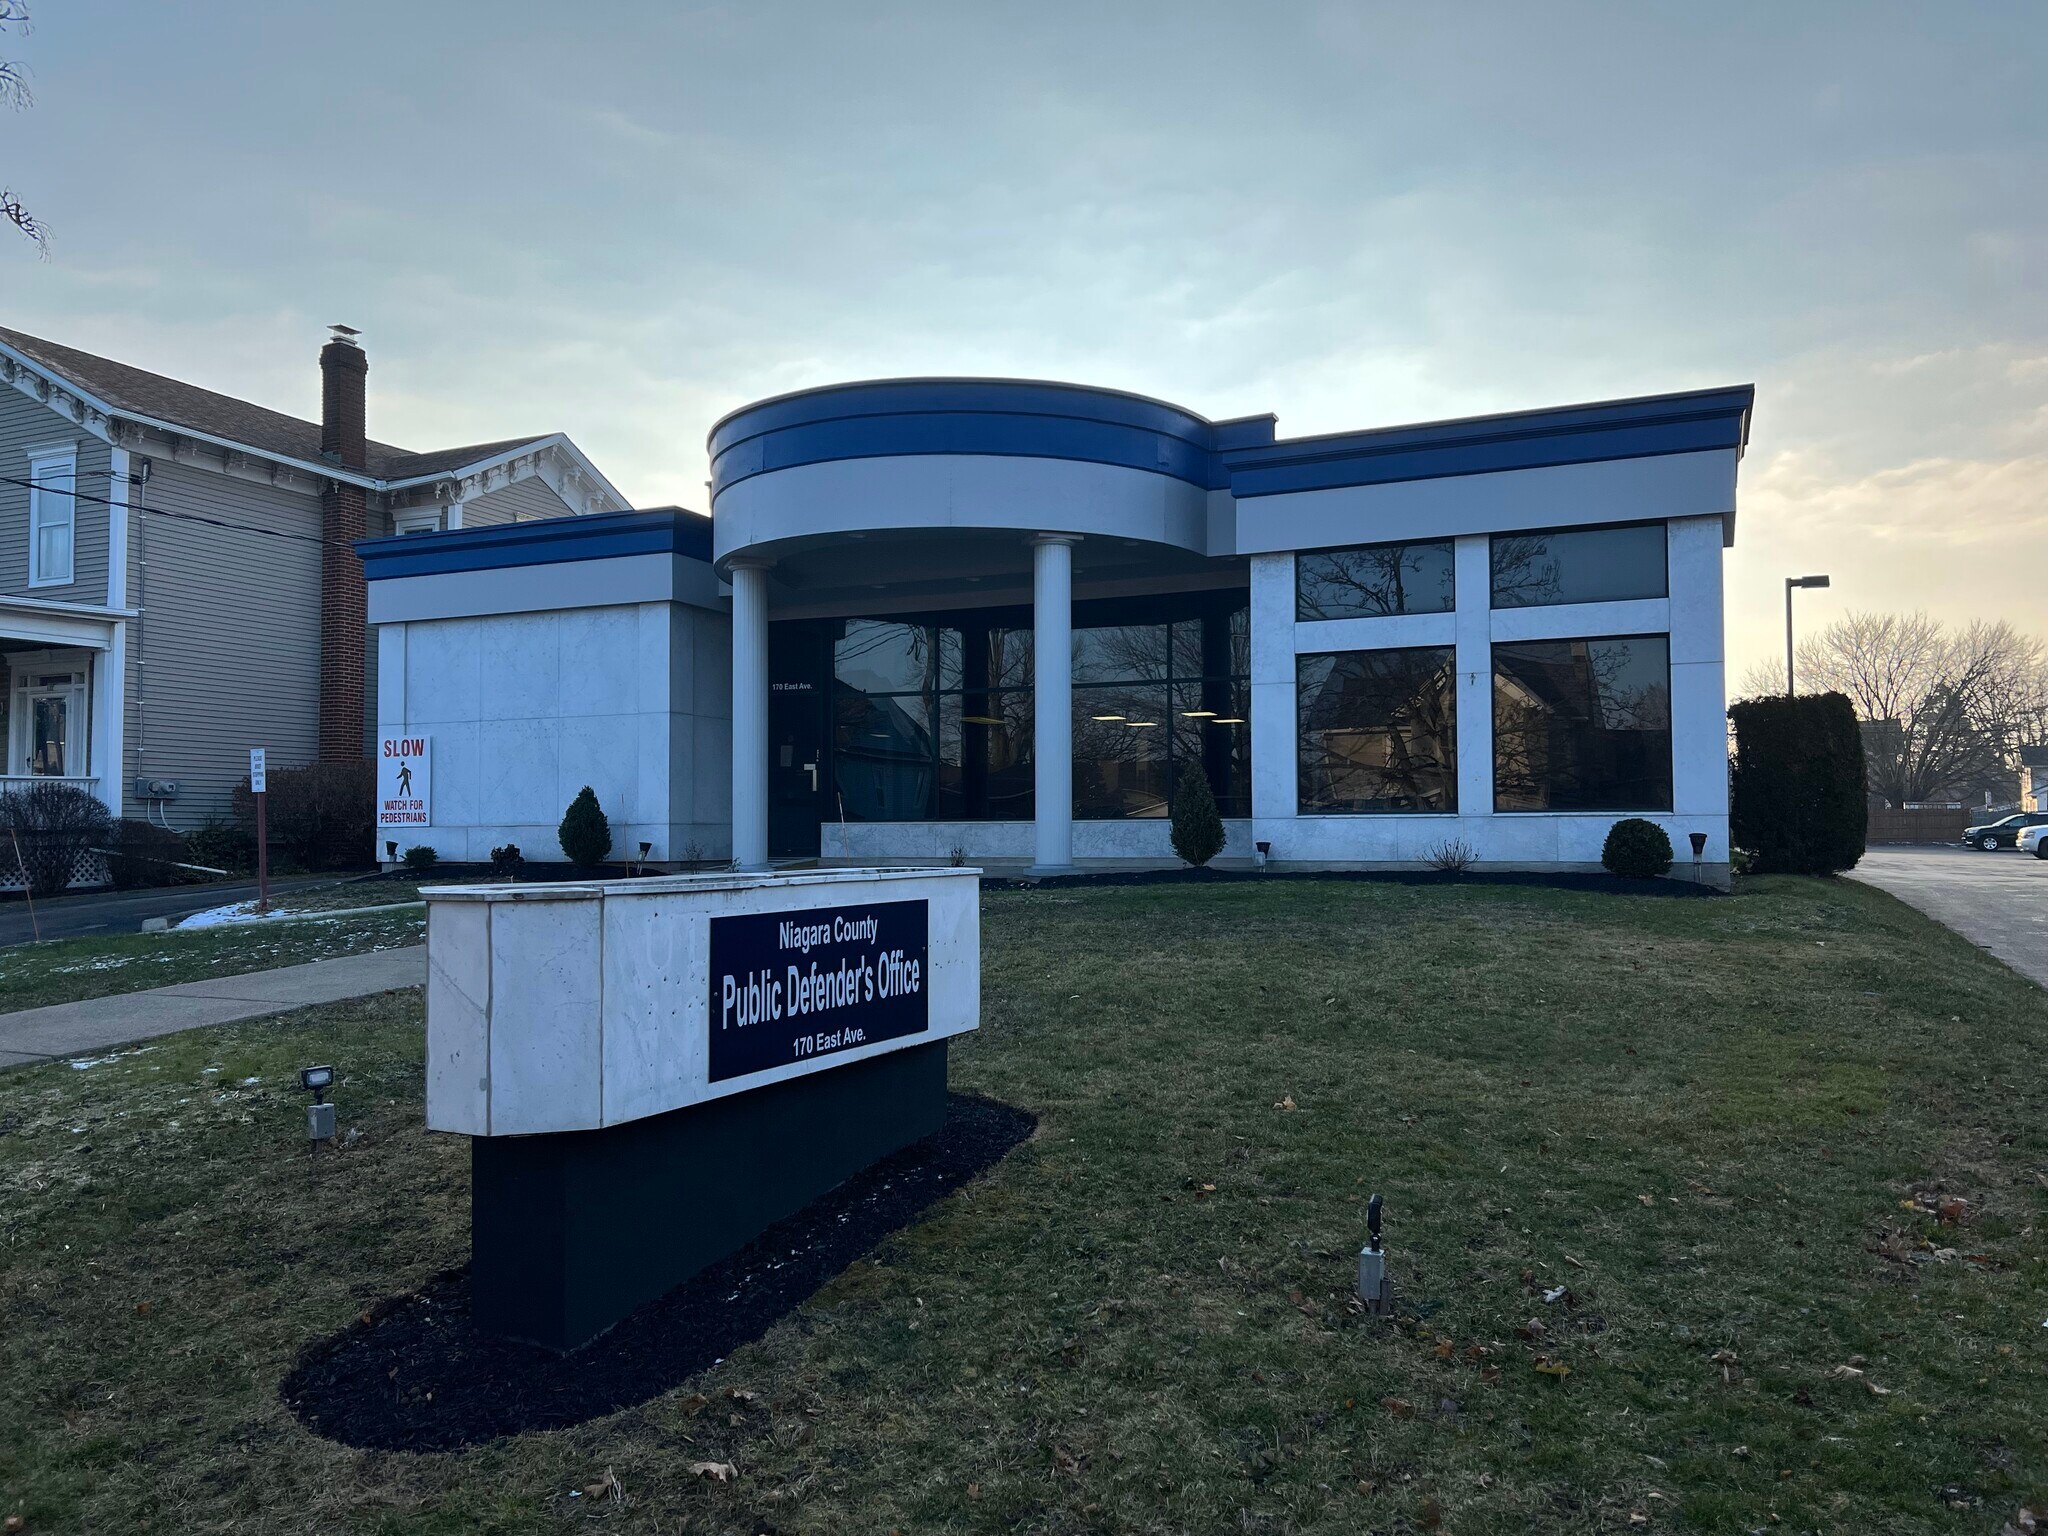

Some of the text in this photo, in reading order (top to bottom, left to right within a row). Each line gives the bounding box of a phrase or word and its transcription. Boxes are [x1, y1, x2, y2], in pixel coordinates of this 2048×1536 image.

[799, 682, 813, 690] Ave.
[384, 739, 425, 757] SLOW
[384, 800, 423, 811] WATCH FOR
[381, 812, 427, 823] PEDESTRIANS
[779, 914, 878, 954] Niagara County
[722, 949, 920, 1030] Public Defender's Office
[793, 1026, 866, 1057] 170 East Ave.
